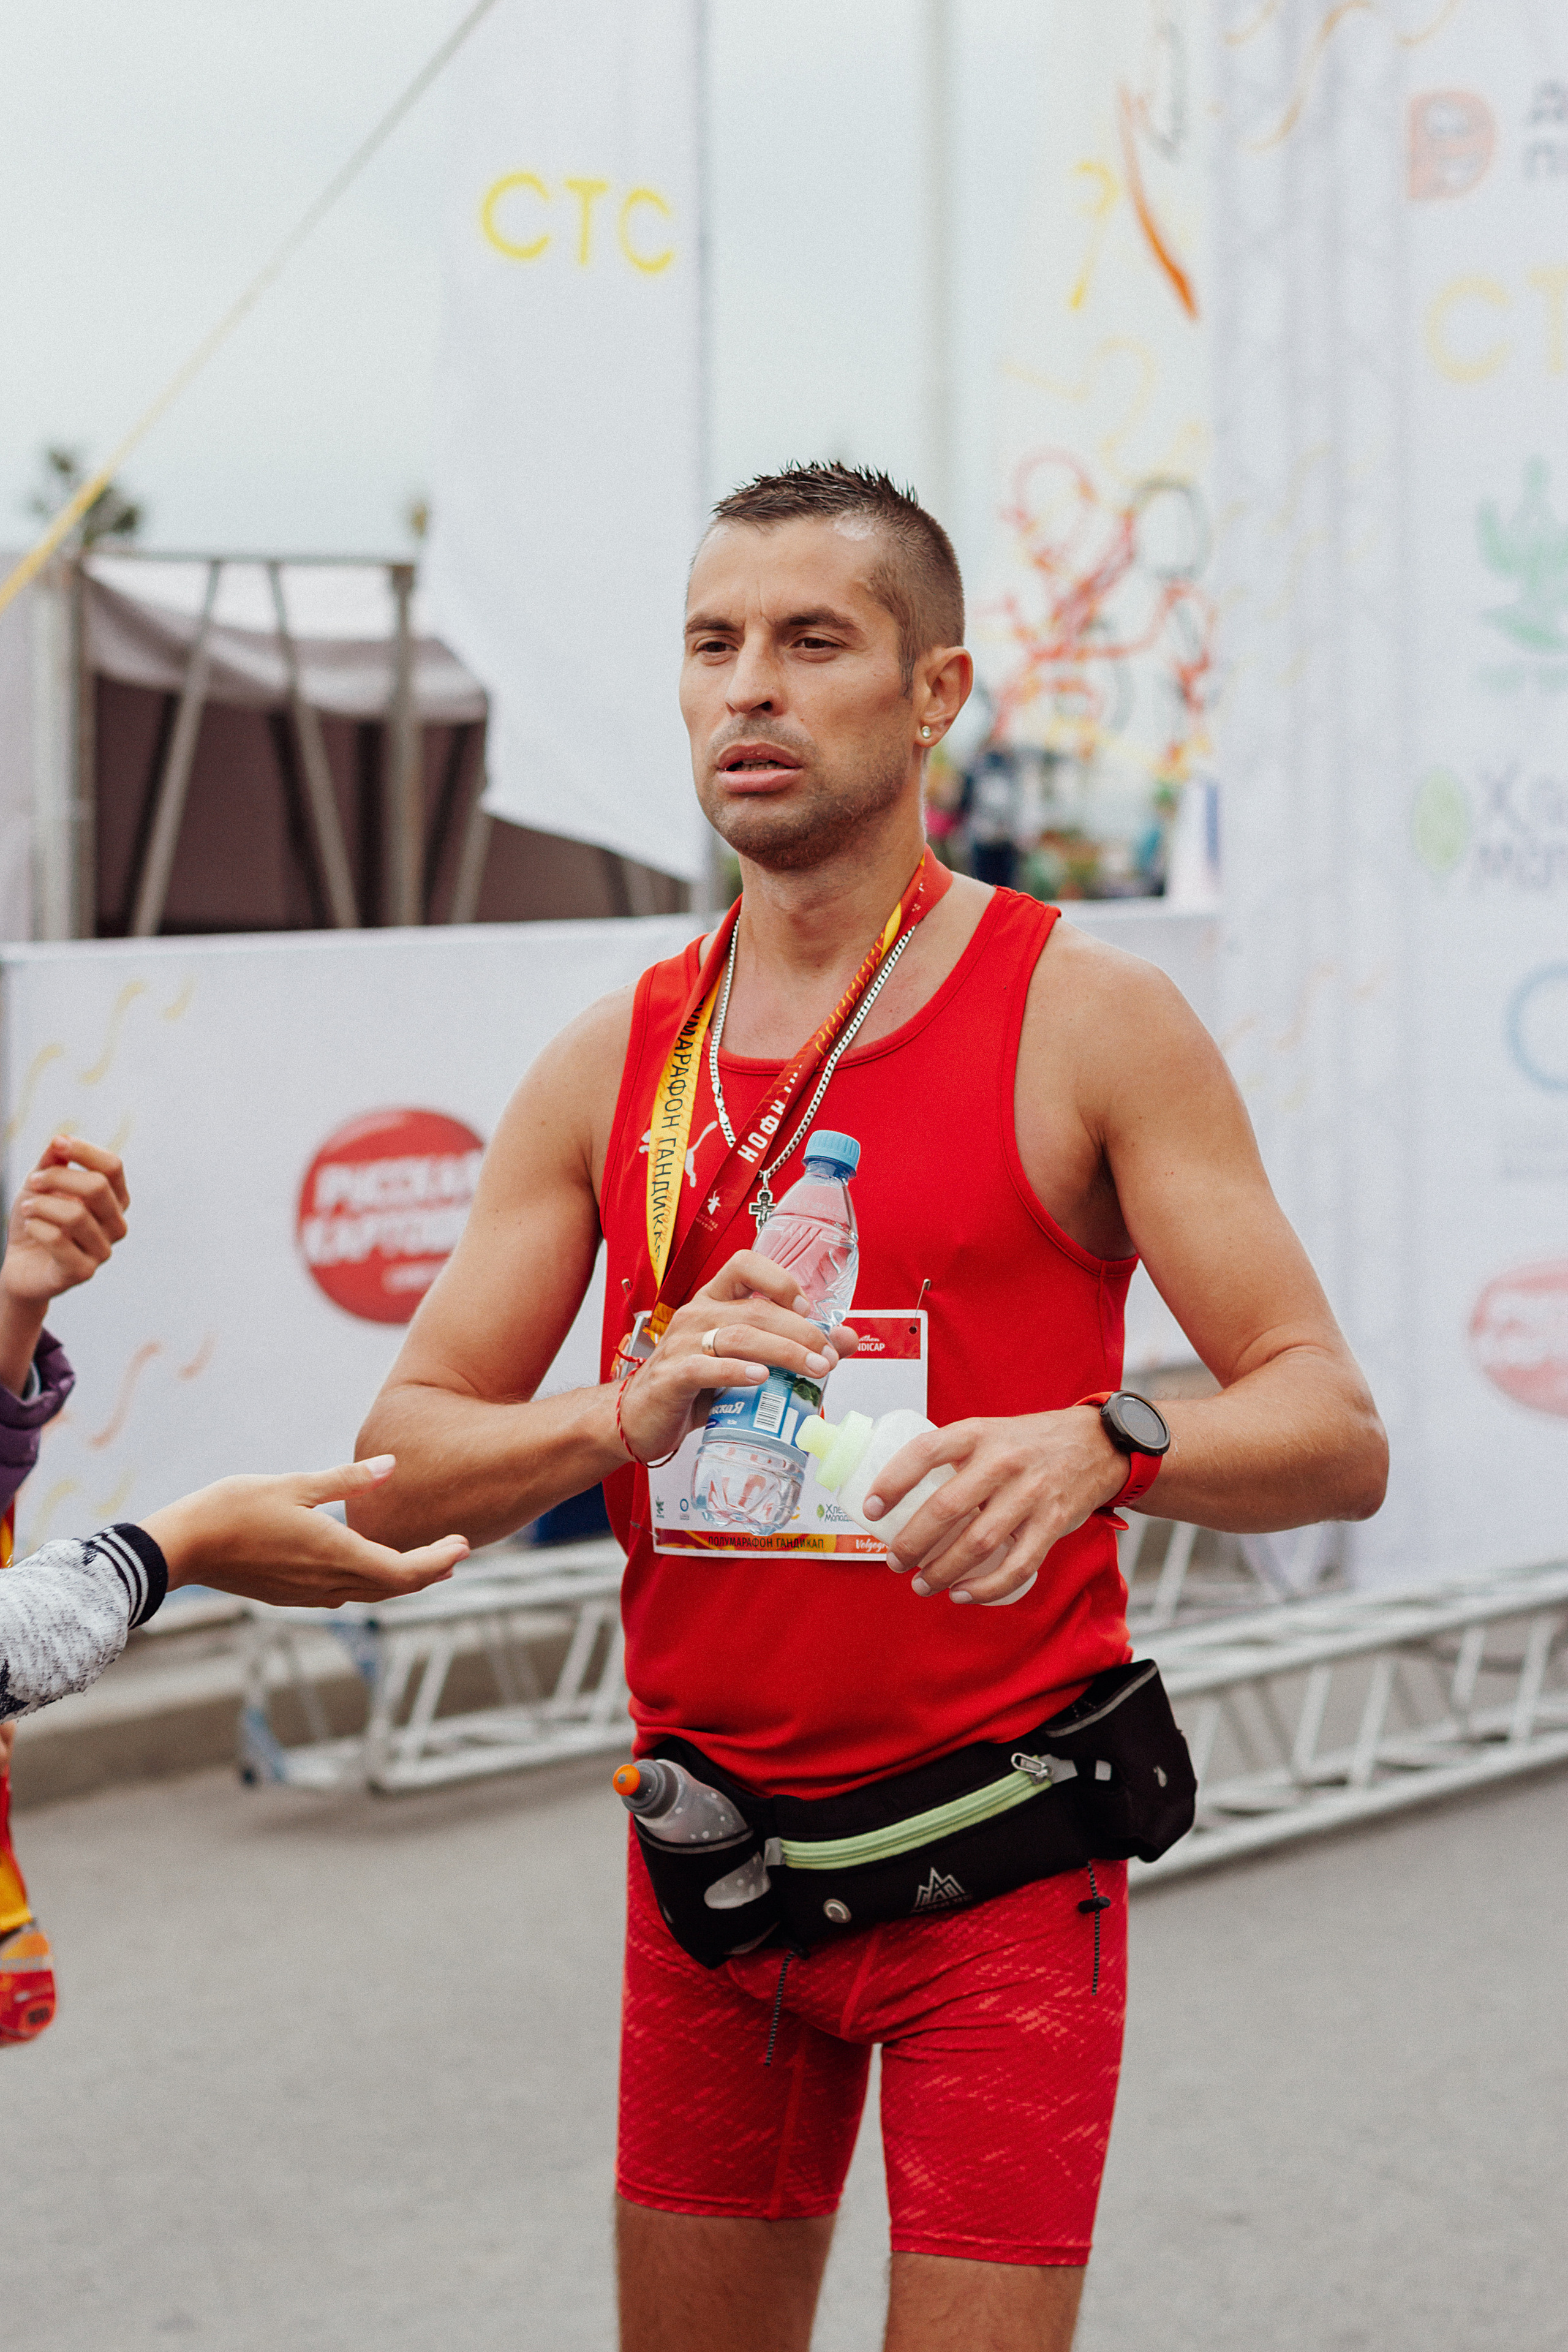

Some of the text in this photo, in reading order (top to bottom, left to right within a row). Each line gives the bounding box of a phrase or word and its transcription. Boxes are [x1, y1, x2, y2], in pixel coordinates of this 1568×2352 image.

[1425, 270, 1568, 386] СТ
[858, 1342, 885, 1352] NDICAP
[708, 1536, 824, 1550] ПОЛУМАРАФОН ГАНДИКАП
